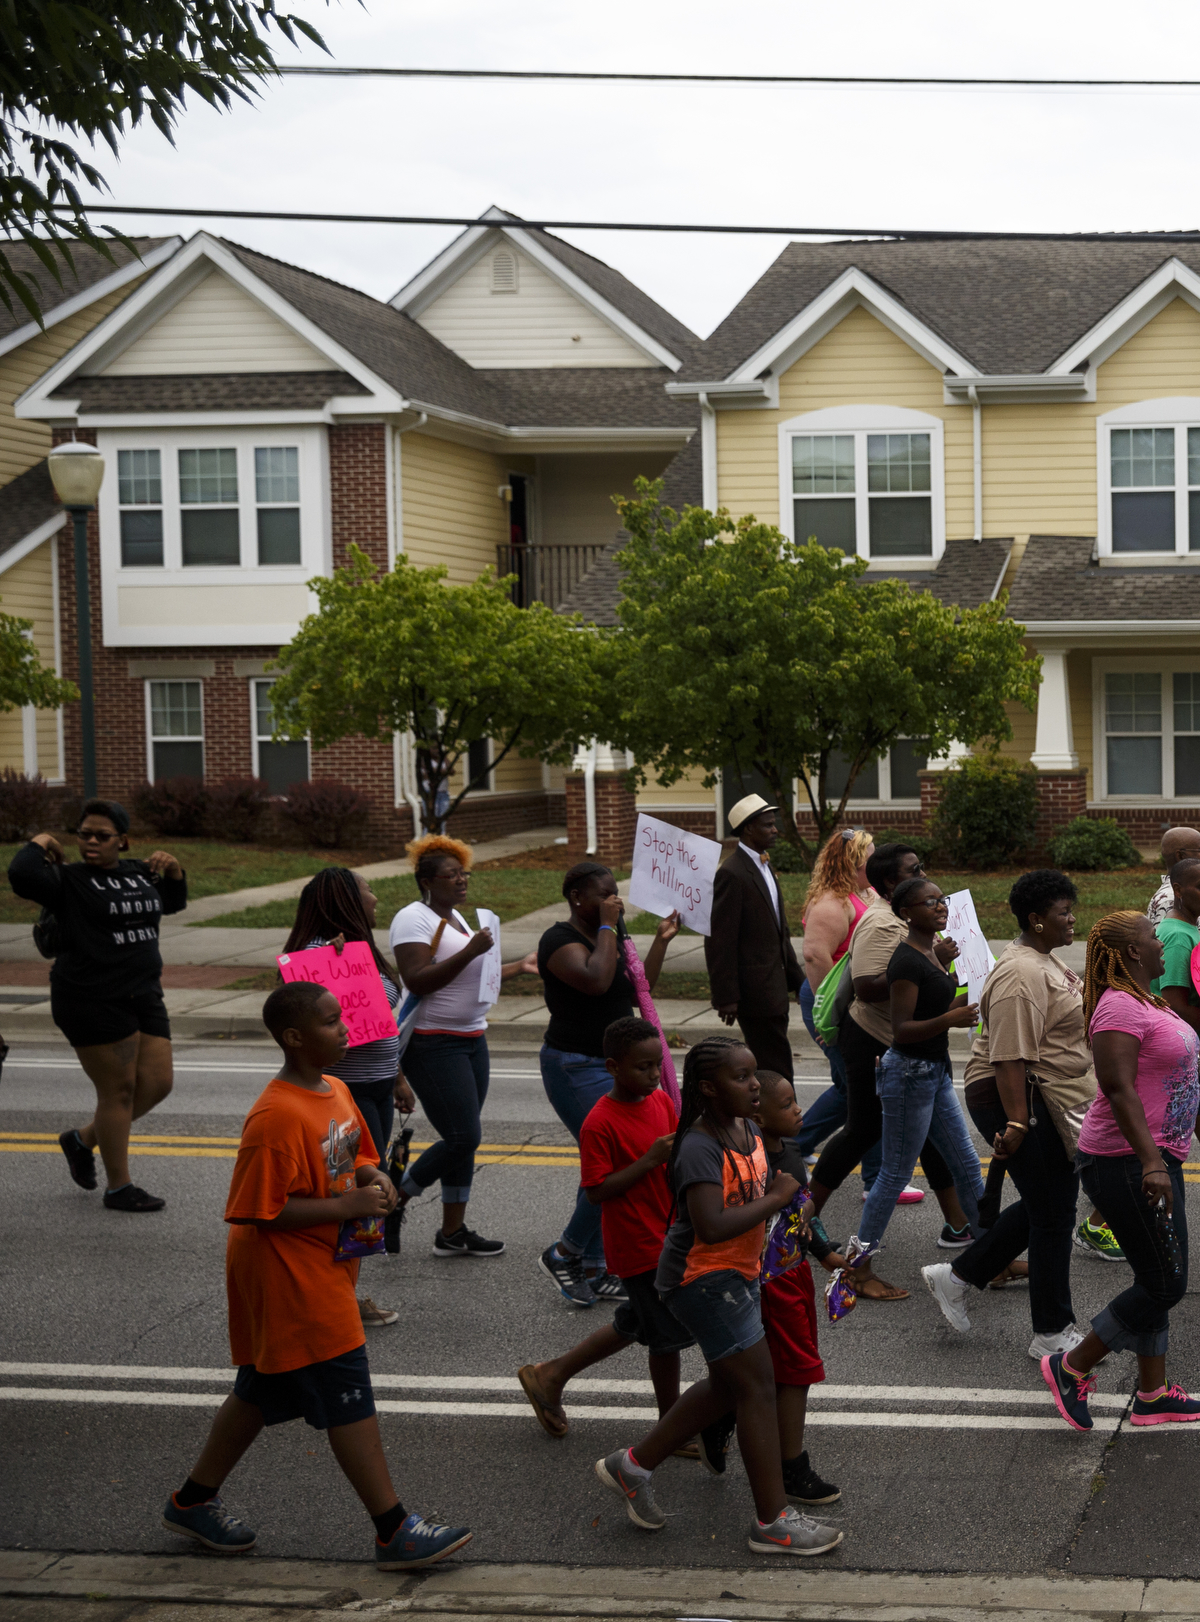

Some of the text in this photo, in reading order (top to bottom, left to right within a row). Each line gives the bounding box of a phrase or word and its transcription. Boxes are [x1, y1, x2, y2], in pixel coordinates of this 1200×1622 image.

[642, 826, 699, 871] Stop the
[109, 898, 161, 915] AMOUR
